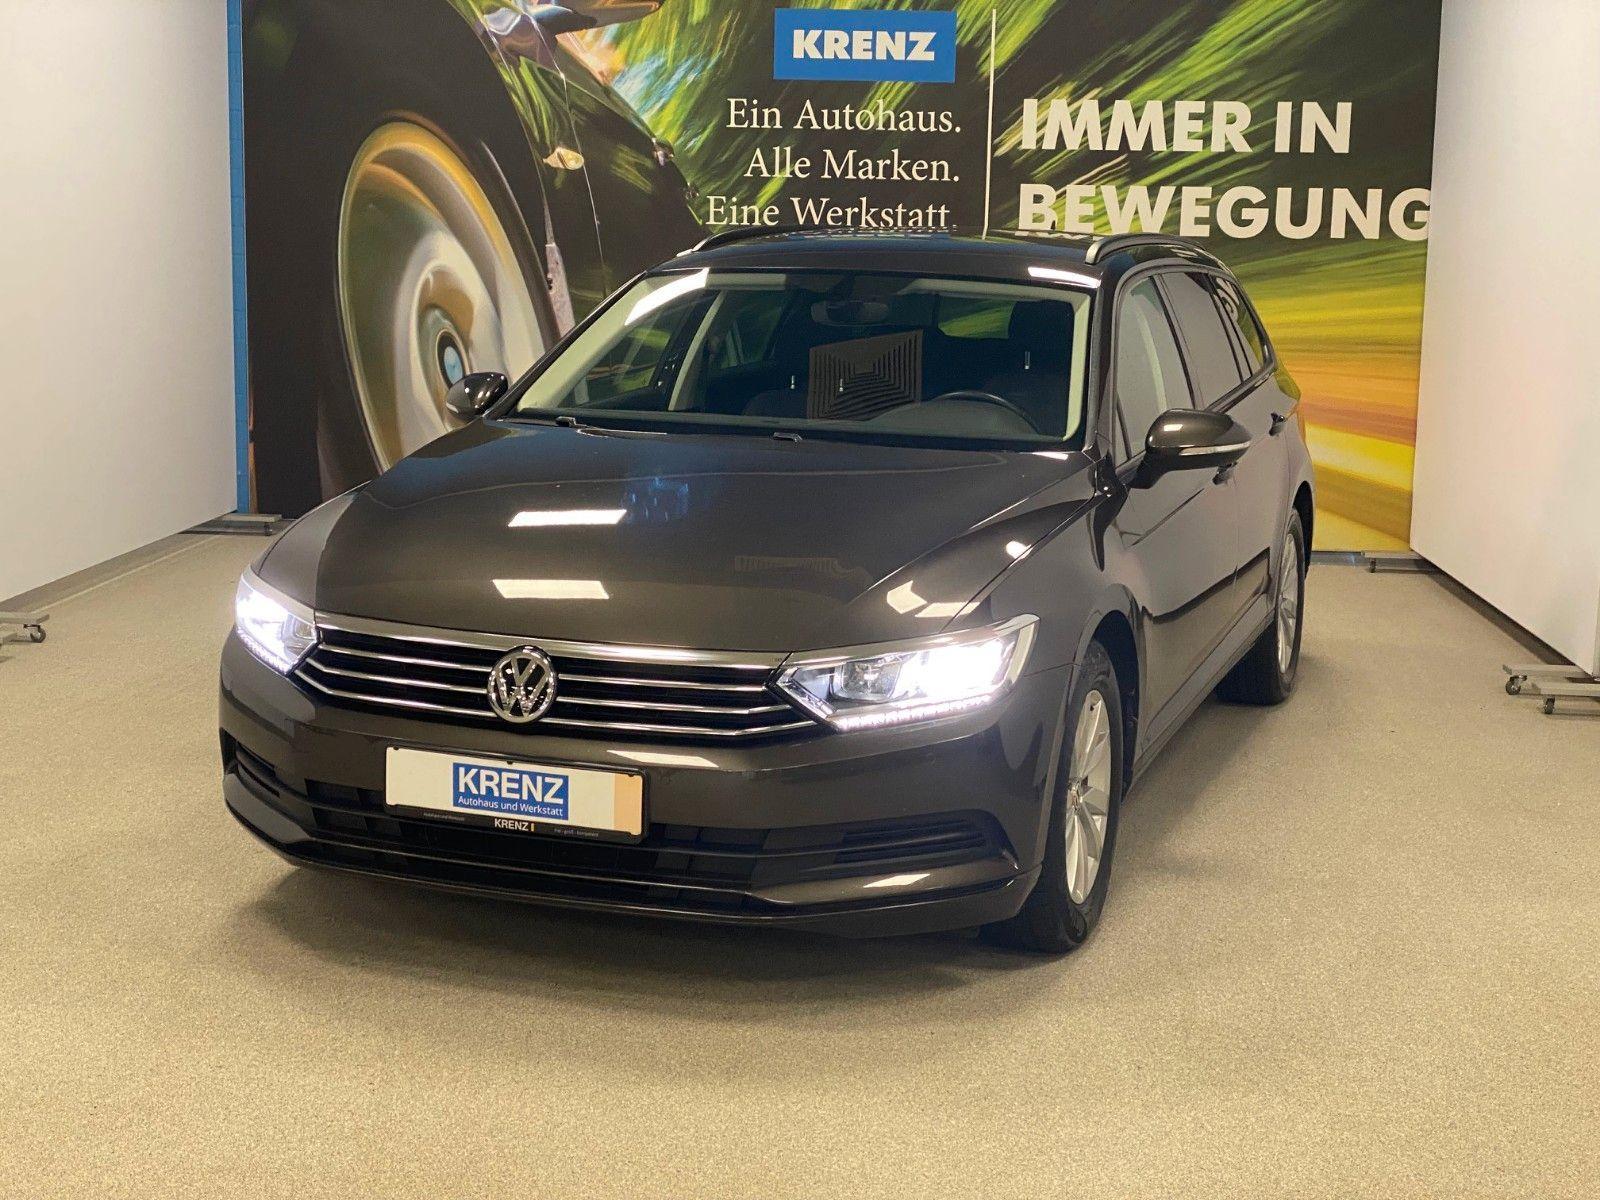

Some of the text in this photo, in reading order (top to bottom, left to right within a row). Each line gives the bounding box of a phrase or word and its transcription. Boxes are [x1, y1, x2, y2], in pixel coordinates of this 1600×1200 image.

[793, 29, 937, 61] KRENZ
[727, 98, 961, 133] Ein Autohaus.
[1019, 98, 1352, 154] IMMER IN
[743, 146, 959, 182] Alle Marken.
[706, 195, 780, 226] Eine
[1018, 183, 1432, 240] BEWEGUNG
[458, 766, 564, 804] KRENZ
[458, 795, 563, 816] Autohaus und Werkstatt
[494, 818, 529, 831] KRENZ
